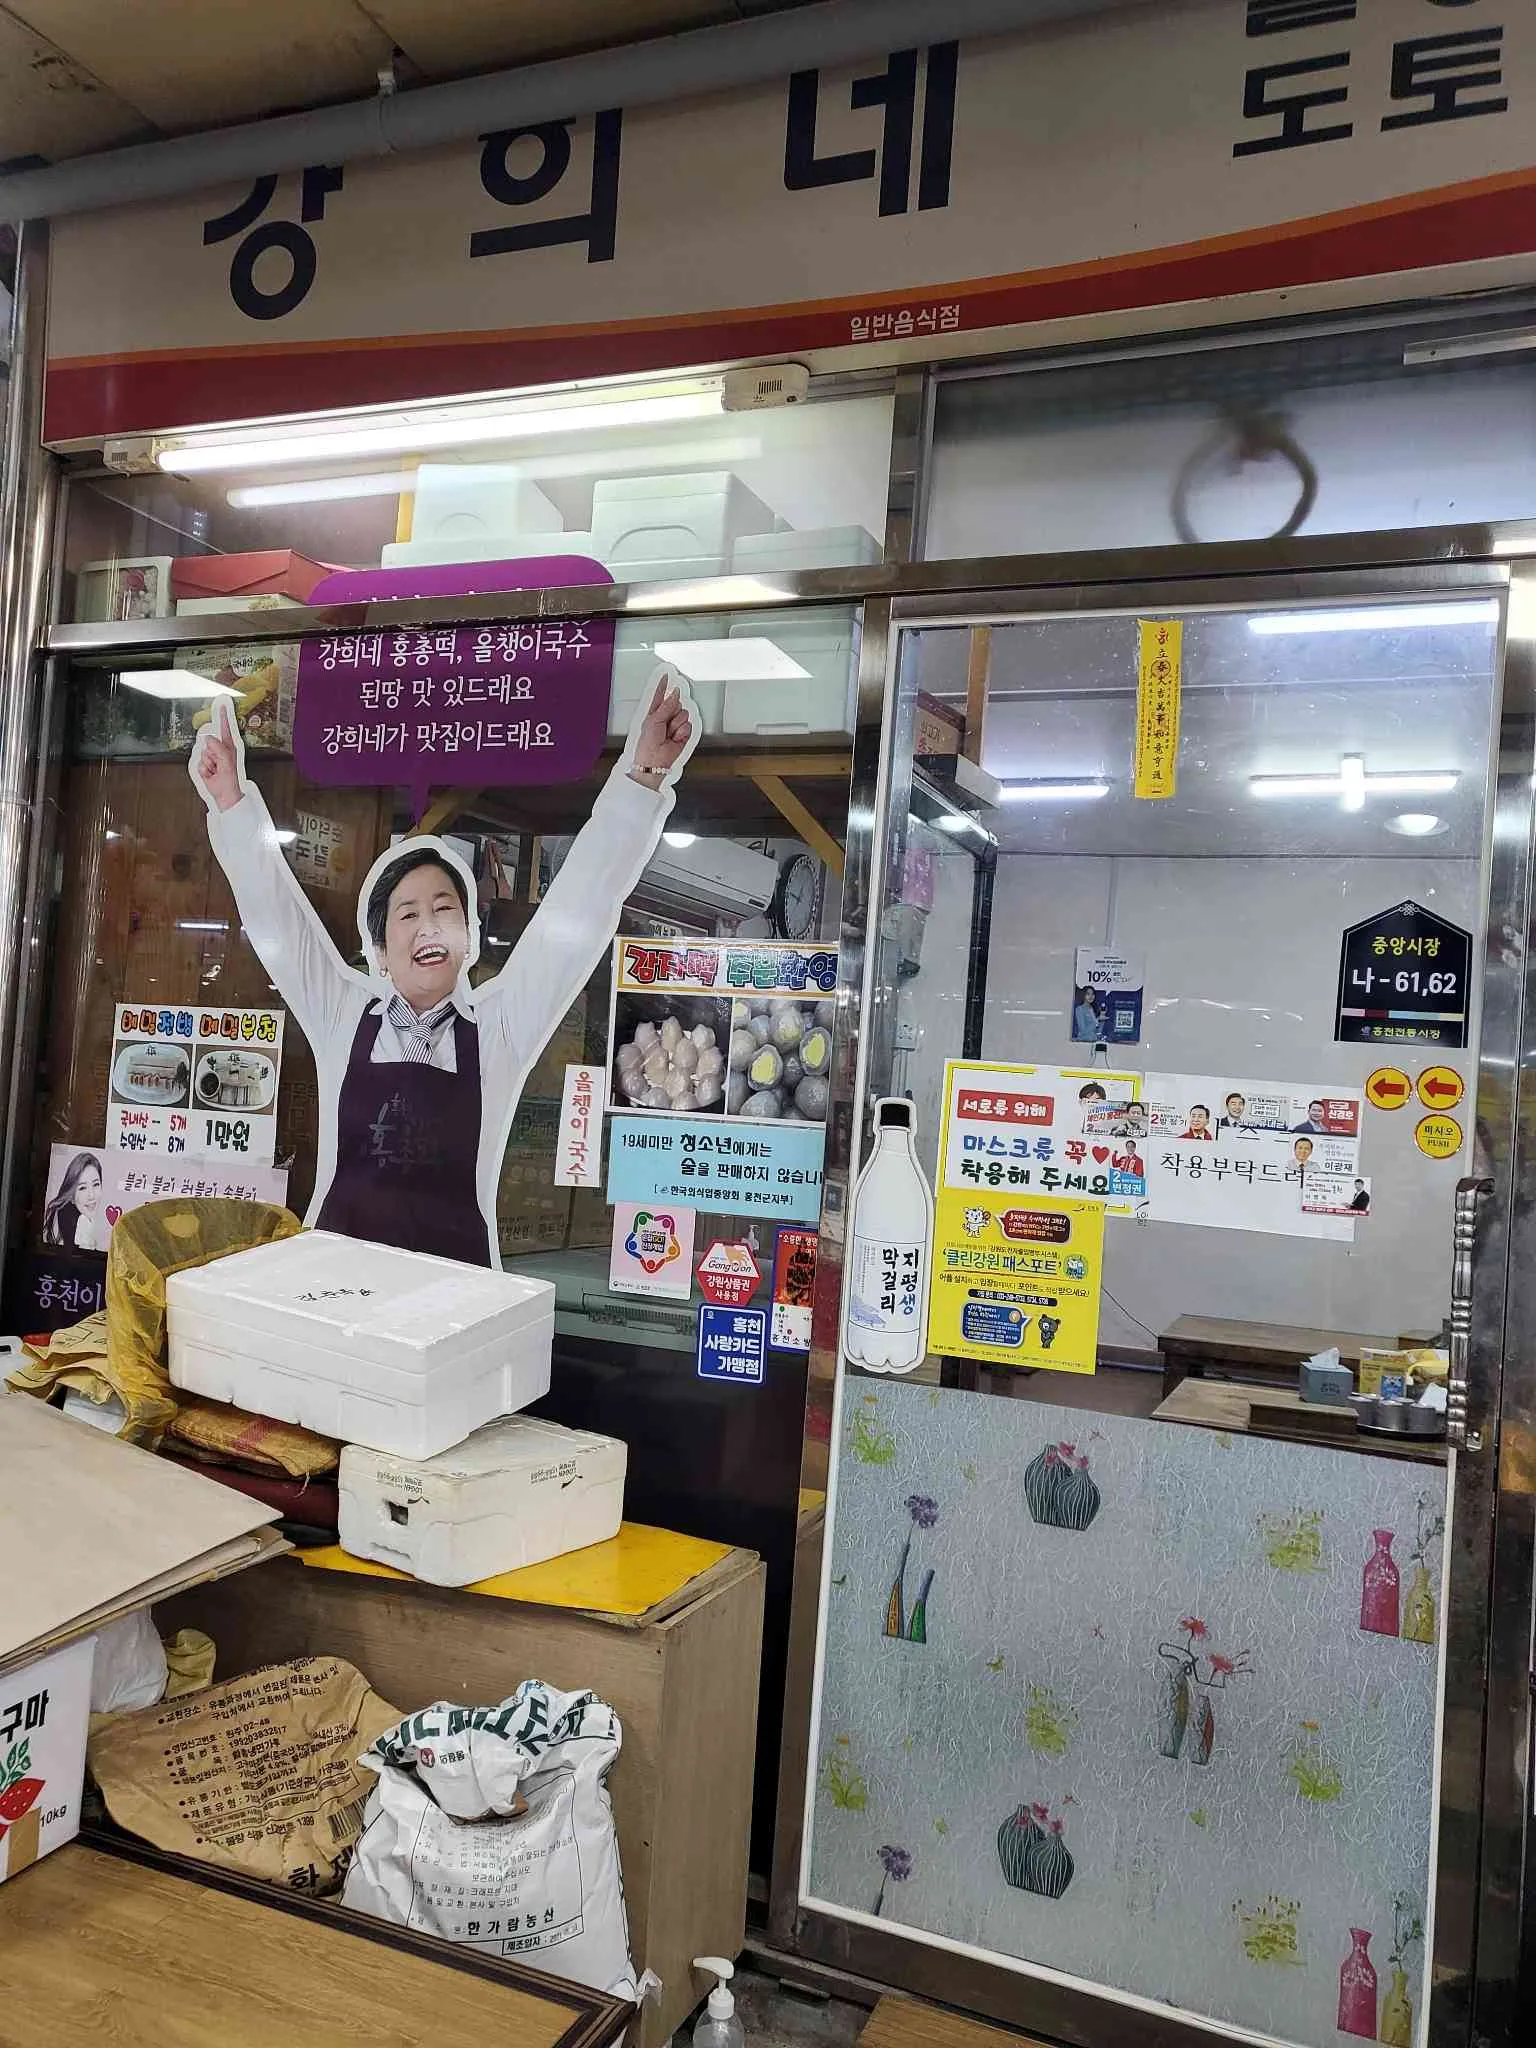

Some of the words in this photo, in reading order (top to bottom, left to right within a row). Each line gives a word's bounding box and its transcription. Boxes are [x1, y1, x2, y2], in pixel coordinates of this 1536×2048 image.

[850, 303, 960, 341] 일반음식점
[318, 635, 383, 670] 강희네
[472, 628, 592, 664] 올챙이국수
[412, 676, 436, 708] 맛
[443, 673, 535, 707] 있드래요
[321, 722, 409, 755] 강희네가
[417, 719, 555, 752] 맛집이드래요
[1371, 936, 1442, 957] 중앙시장
[1087, 970, 1112, 983] 10%
[962, 1098, 1009, 1115] 서로를
[1013, 1102, 1047, 1117] 위해
[1151, 1113, 1159, 1124] 2
[120, 1110, 149, 1128] 국내산
[169, 1112, 187, 1130] 5개
[120, 1133, 147, 1151] 수입산
[167, 1136, 185, 1152] 8개
[205, 1119, 250, 1152] 1만원
[622, 1134, 673, 1151] 19세미만
[680, 1133, 773, 1158] 청소년에게는
[963, 1135, 1055, 1161] 마스크를
[1065, 1140, 1087, 1165] 꼭
[680, 1158, 710, 1177] 술을
[717, 1163, 769, 1181] 판매하지
[961, 1159, 1031, 1185] 착용해
[1040, 1167, 1110, 1195] 주세요
[1113, 1171, 1121, 1182] 2
[706, 1276, 751, 1292] 강원상품권
[881, 1247, 899, 1315] 막걸리
[900, 1248, 919, 1315] 지평생
[715, 1290, 739, 1302] 사용점
[731, 1316, 761, 1334] 홍천
[704, 1335, 760, 1355] 사랑카드
[717, 1355, 760, 1375] 가맹점
[40, 1804, 67, 1828] 10kg
